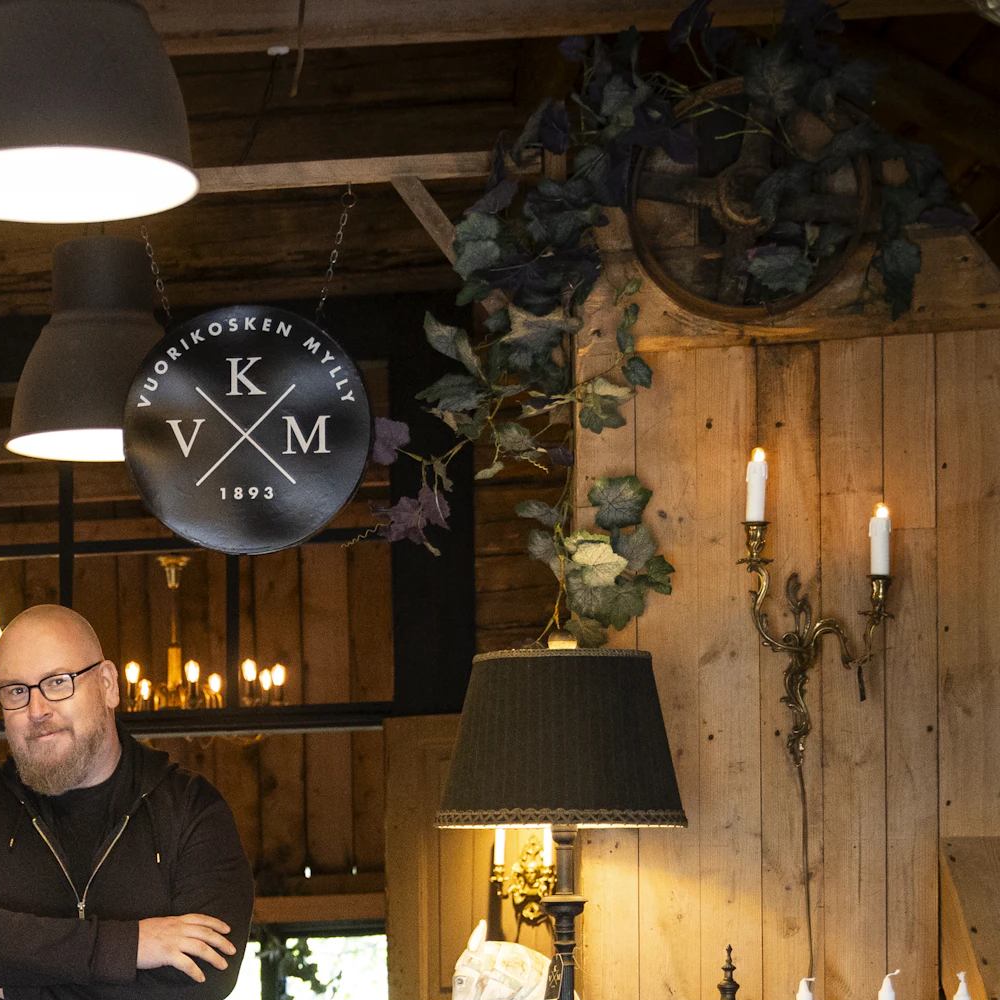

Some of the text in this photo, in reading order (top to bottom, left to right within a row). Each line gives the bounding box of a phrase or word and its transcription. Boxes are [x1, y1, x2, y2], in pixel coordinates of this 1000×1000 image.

[137, 317, 355, 408] VUORIKOSKEN MYLLY
[225, 356, 267, 396] K
[165, 415, 332, 458] V M
[219, 486, 274, 500] 1893
